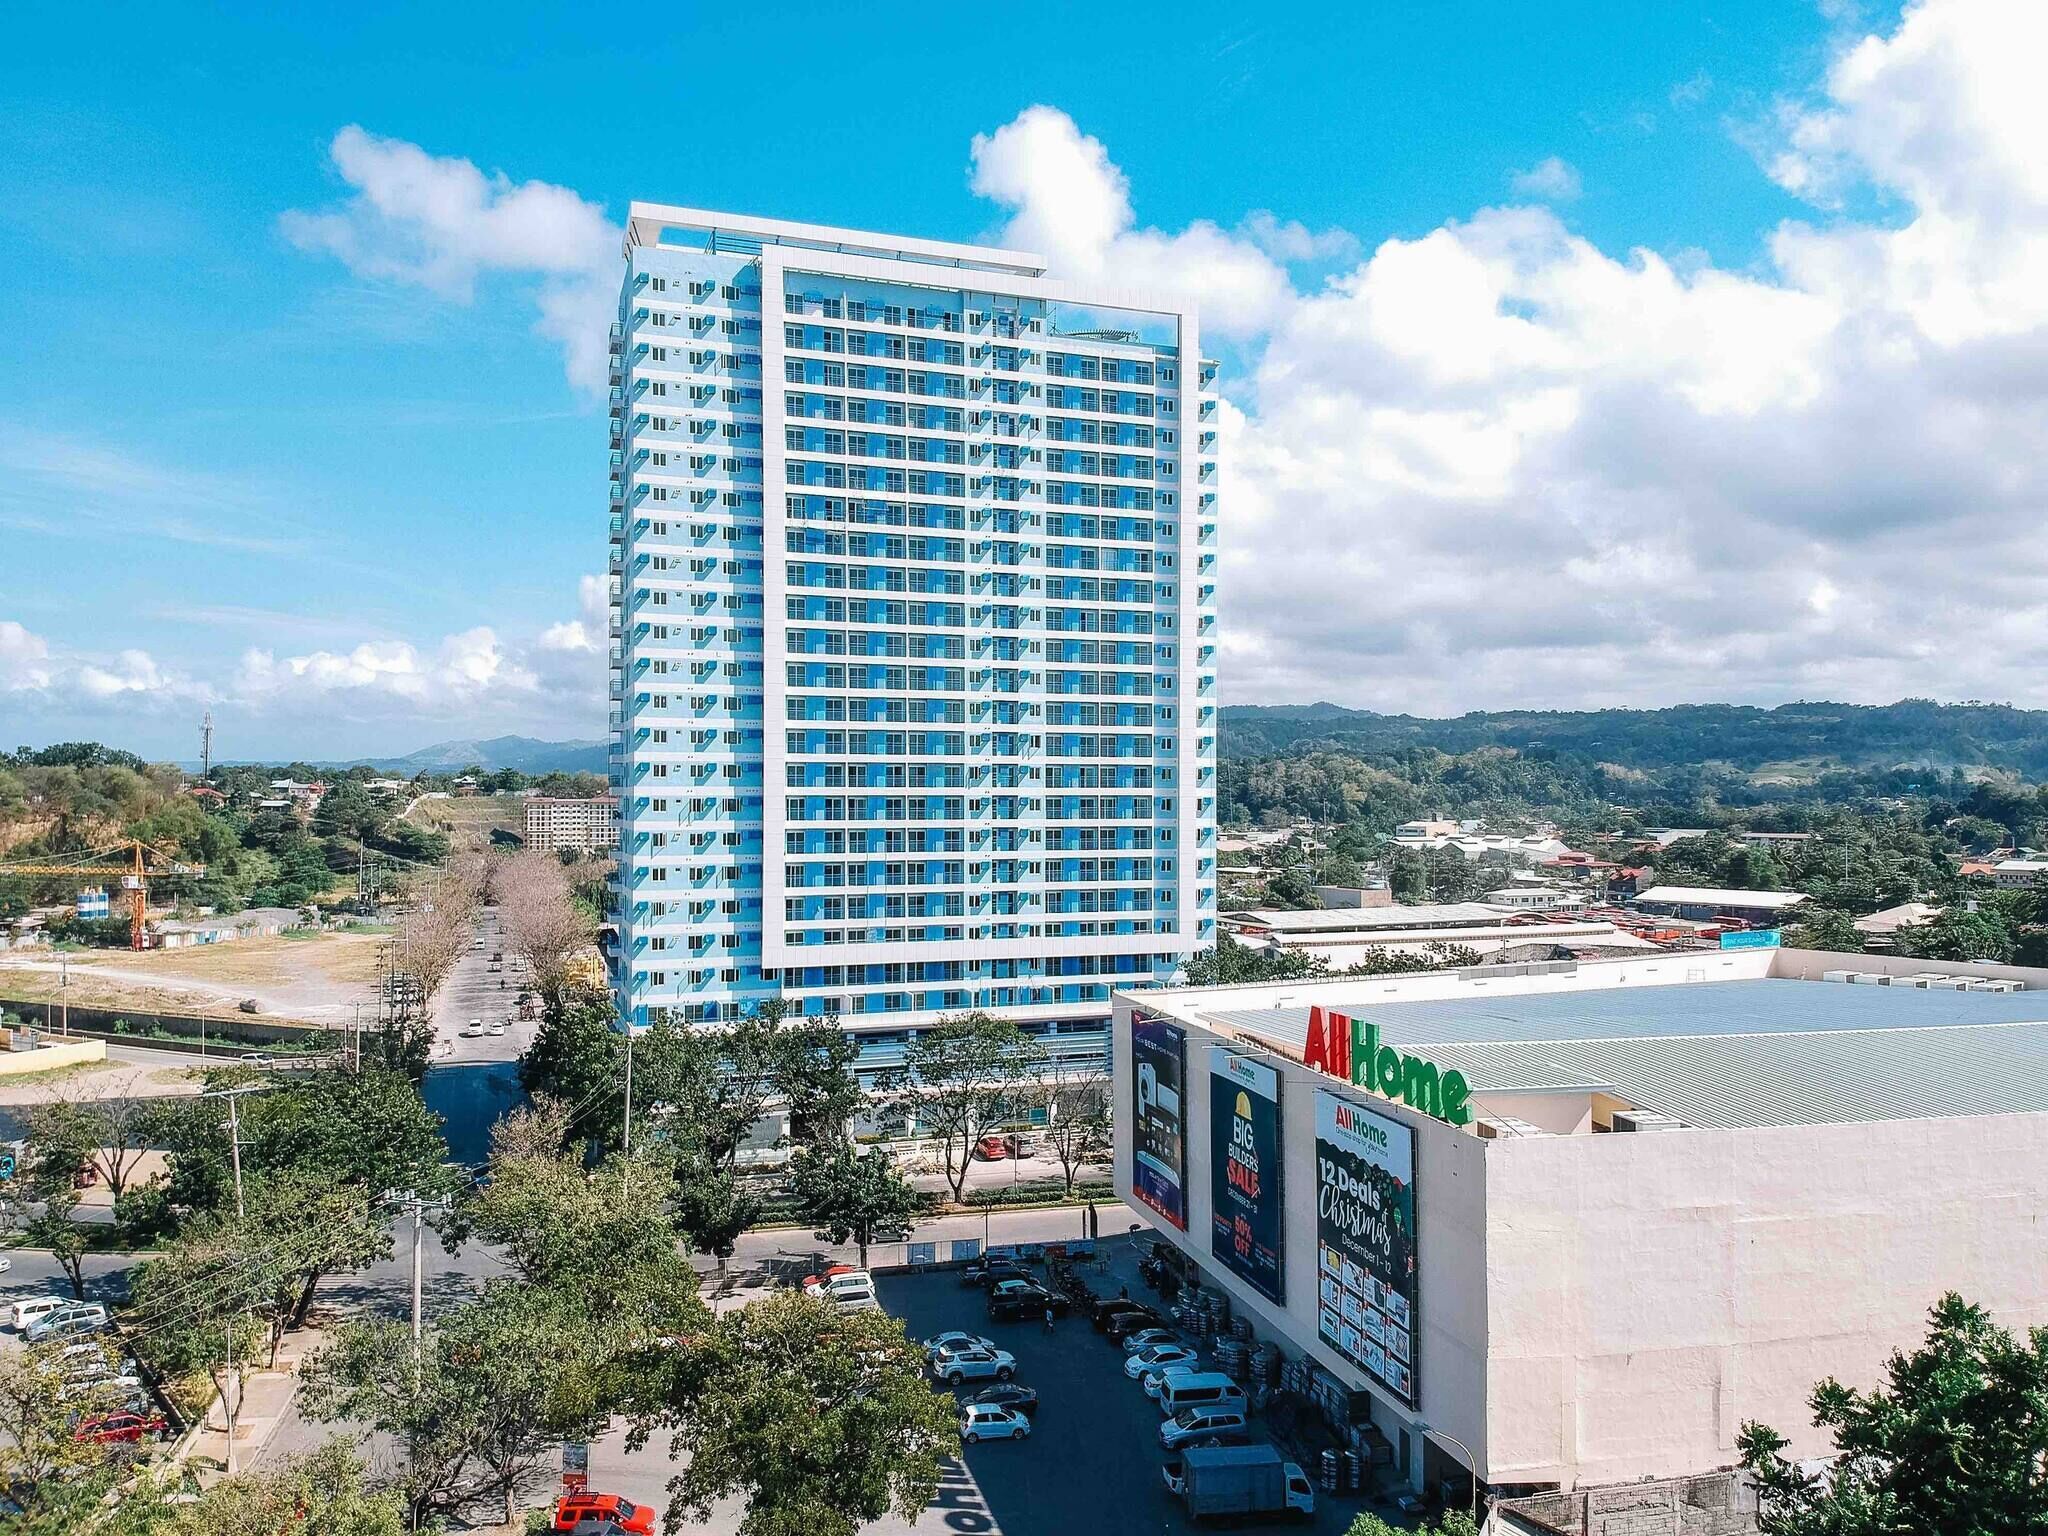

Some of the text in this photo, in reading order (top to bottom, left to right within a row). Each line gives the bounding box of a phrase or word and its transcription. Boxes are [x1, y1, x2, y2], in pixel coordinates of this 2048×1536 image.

[1144, 1039, 1157, 1050] BEST
[1304, 1005, 1473, 1125] AllHome
[1233, 1115, 1253, 1150] BIG
[1336, 1105, 1387, 1147] AllHome
[1228, 1158, 1259, 1198] SALE
[1319, 1156, 1335, 1185] 12
[1338, 1166, 1380, 1211] Deals
[1234, 1215, 1252, 1242] 50%
[1320, 1184, 1391, 1256] Christmas
[1234, 1234, 1250, 1257] OFF
[1341, 1233, 1375, 1264] December
